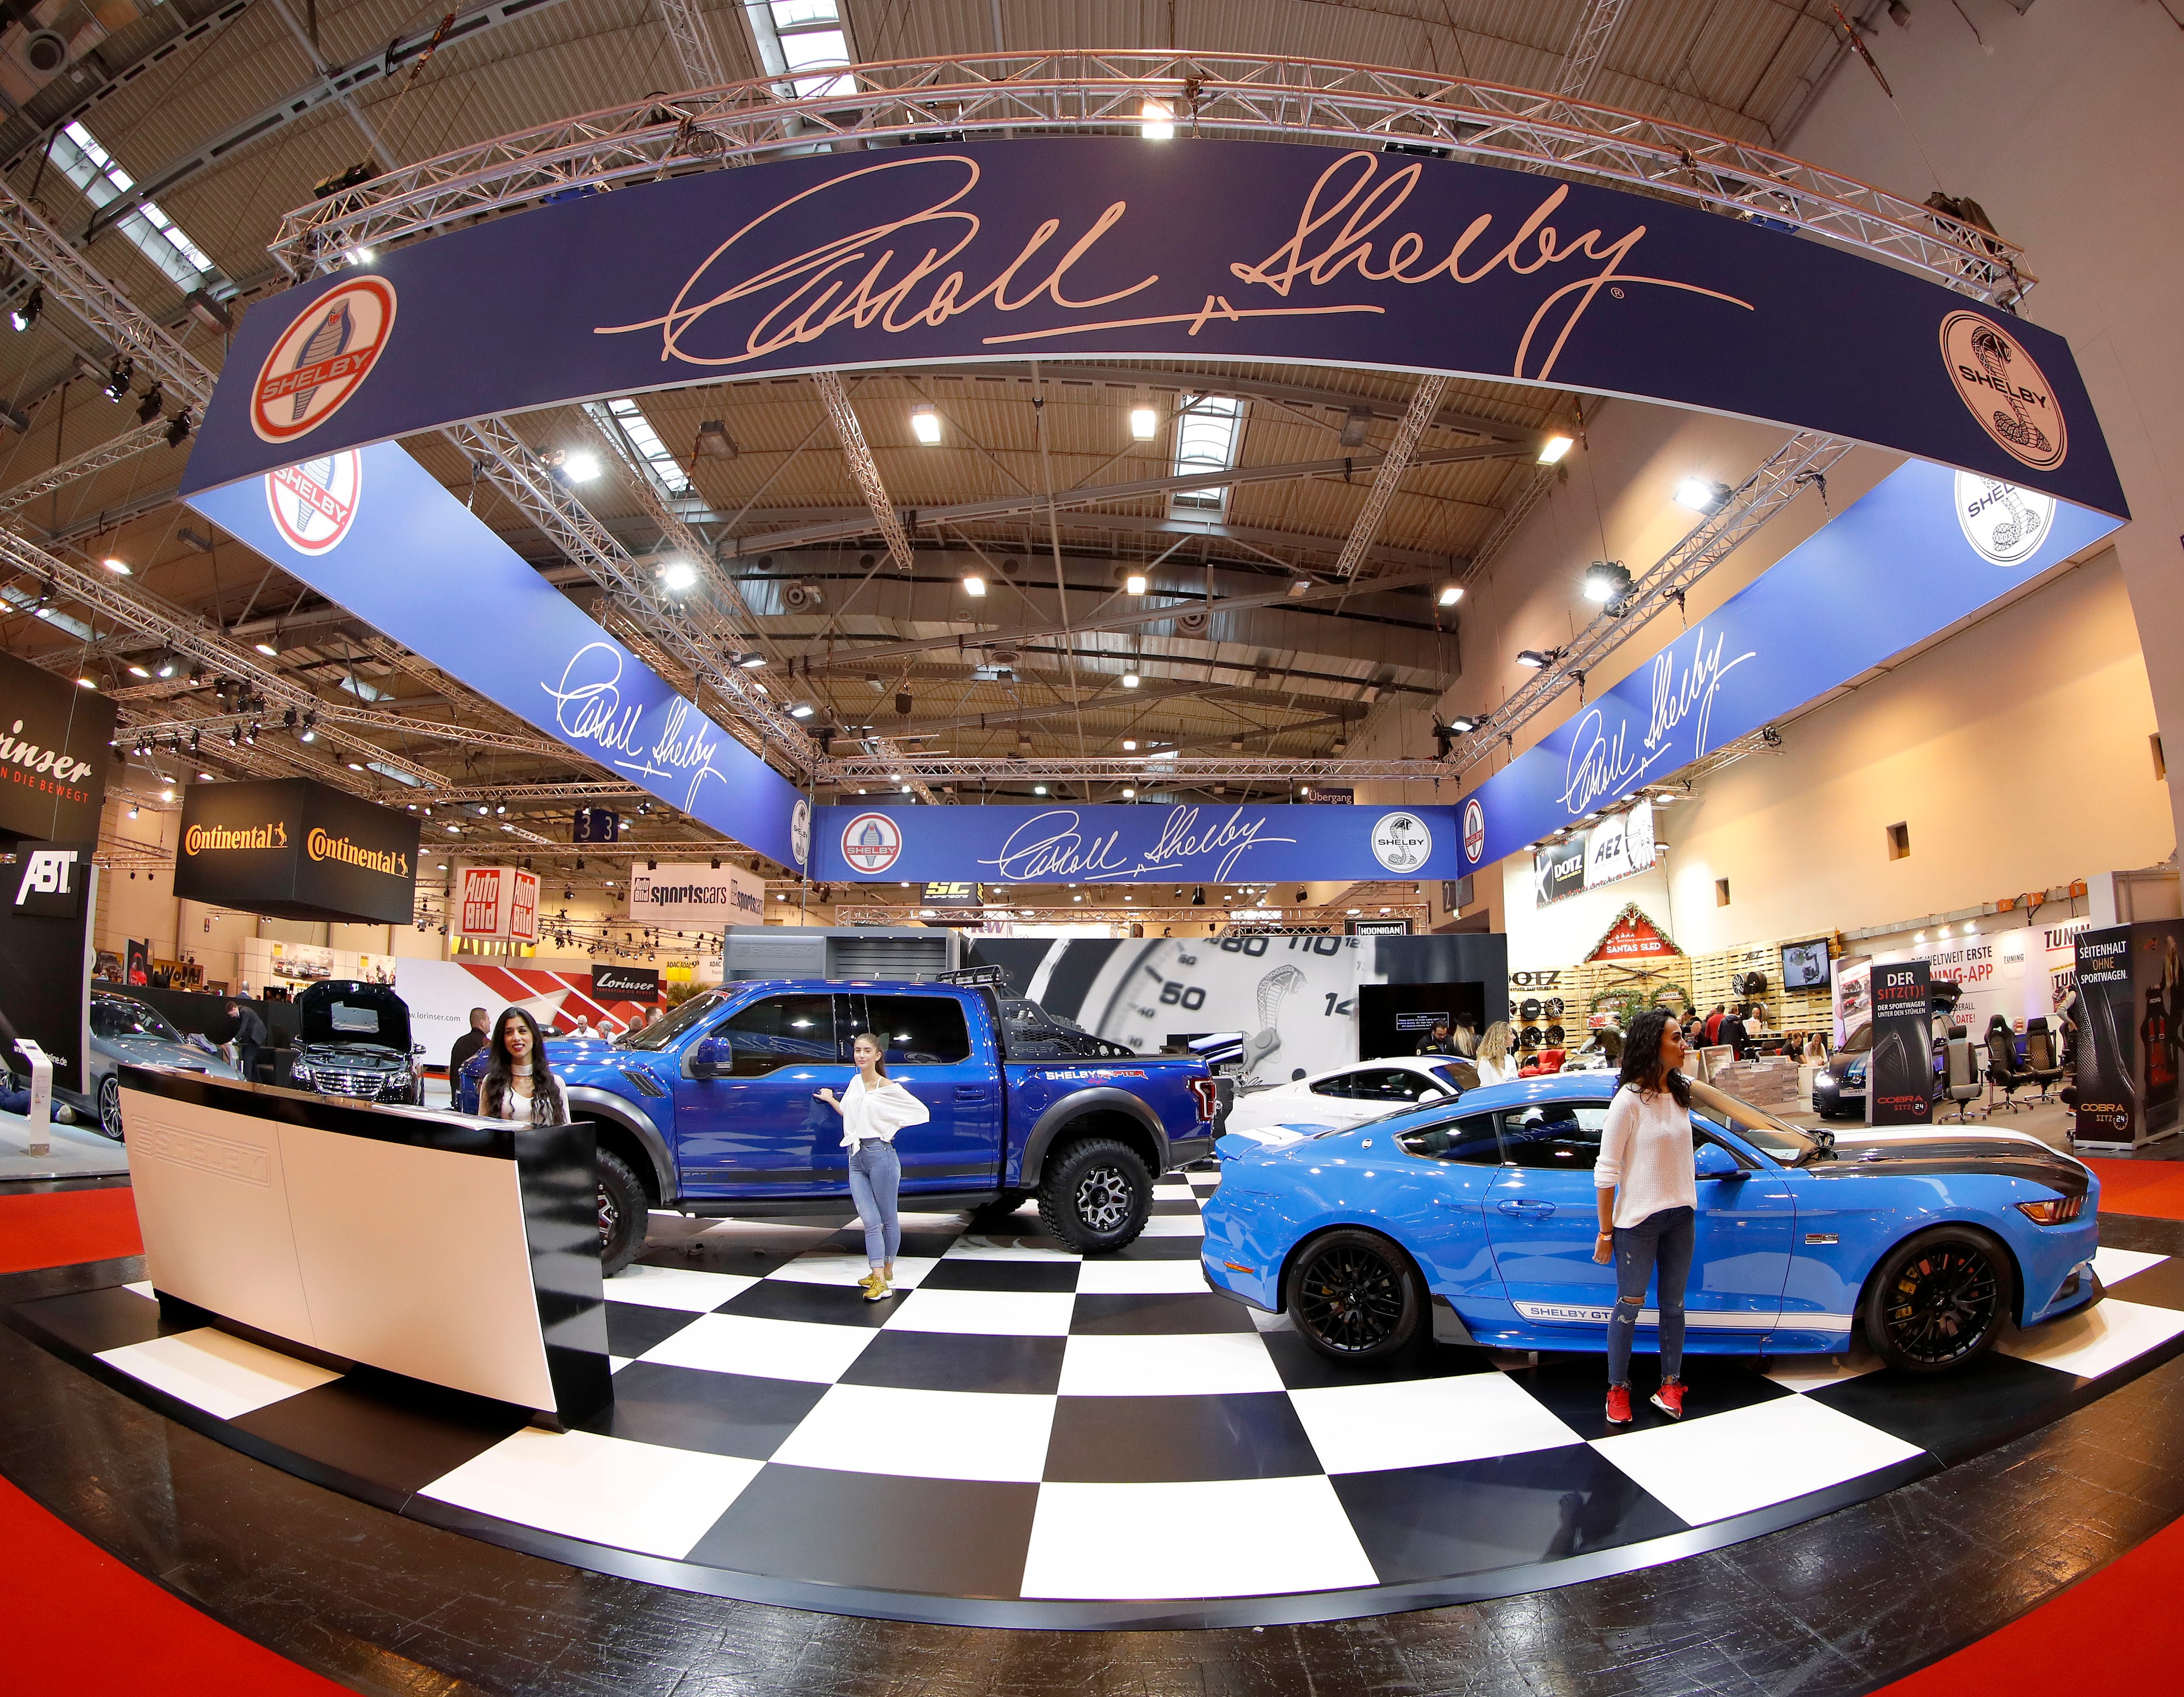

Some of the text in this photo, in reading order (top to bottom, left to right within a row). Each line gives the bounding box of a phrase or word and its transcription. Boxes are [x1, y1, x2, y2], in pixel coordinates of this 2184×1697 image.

[262, 350, 373, 400] SHELBY
[1958, 365, 2046, 408] SHELBY
[1968, 482, 2015, 518] SHEL
[14, 771, 35, 787] DIE
[40, 780, 89, 803] BEWEGT
[1309, 790, 1352, 804] Übergang
[581, 815, 590, 838] 3
[604, 816, 613, 840] 3
[185, 824, 272, 856] Continental
[1465, 831, 1483, 847] SHELBY
[1595, 834, 1622, 864] AEZ
[307, 827, 396, 875] Continental
[1554, 854, 1583, 879] DOTZ
[15, 850, 78, 905] ABT
[465, 872, 499, 902] Auto
[634, 878, 650, 890] Auto
[514, 876, 535, 909] Auto
[634, 890, 648, 902] Bild
[651, 885, 727, 906] sportscars
[1445, 883, 1450, 909] 2
[465, 903, 496, 930] Bild
[513, 907, 532, 935] Bild
[1606, 944, 1638, 953] SANTAS
[1967, 946, 1992, 961] ERSTE
[2004, 953, 2024, 963] TUNING
[2079, 940, 2126, 959] SEITENHALT
[2092, 957, 2115, 971] OHNE
[596, 972, 655, 990] Lorinser
[1509, 971, 1562, 985] OTZ
[1887, 972, 1914, 986] DER
[2080, 969, 2128, 984] SPORTWAGEN.
[1159, 980, 1206, 1010] 50
[1877, 985, 1925, 1000] SITZ(T)!
[1889, 1001, 1925, 1010] SPORTWAGEN
[1045, 1071, 1097, 1080] SHELBY
[1877, 1095, 1923, 1104] COBRA
[1531, 1307, 1587, 1318] SHELBY
